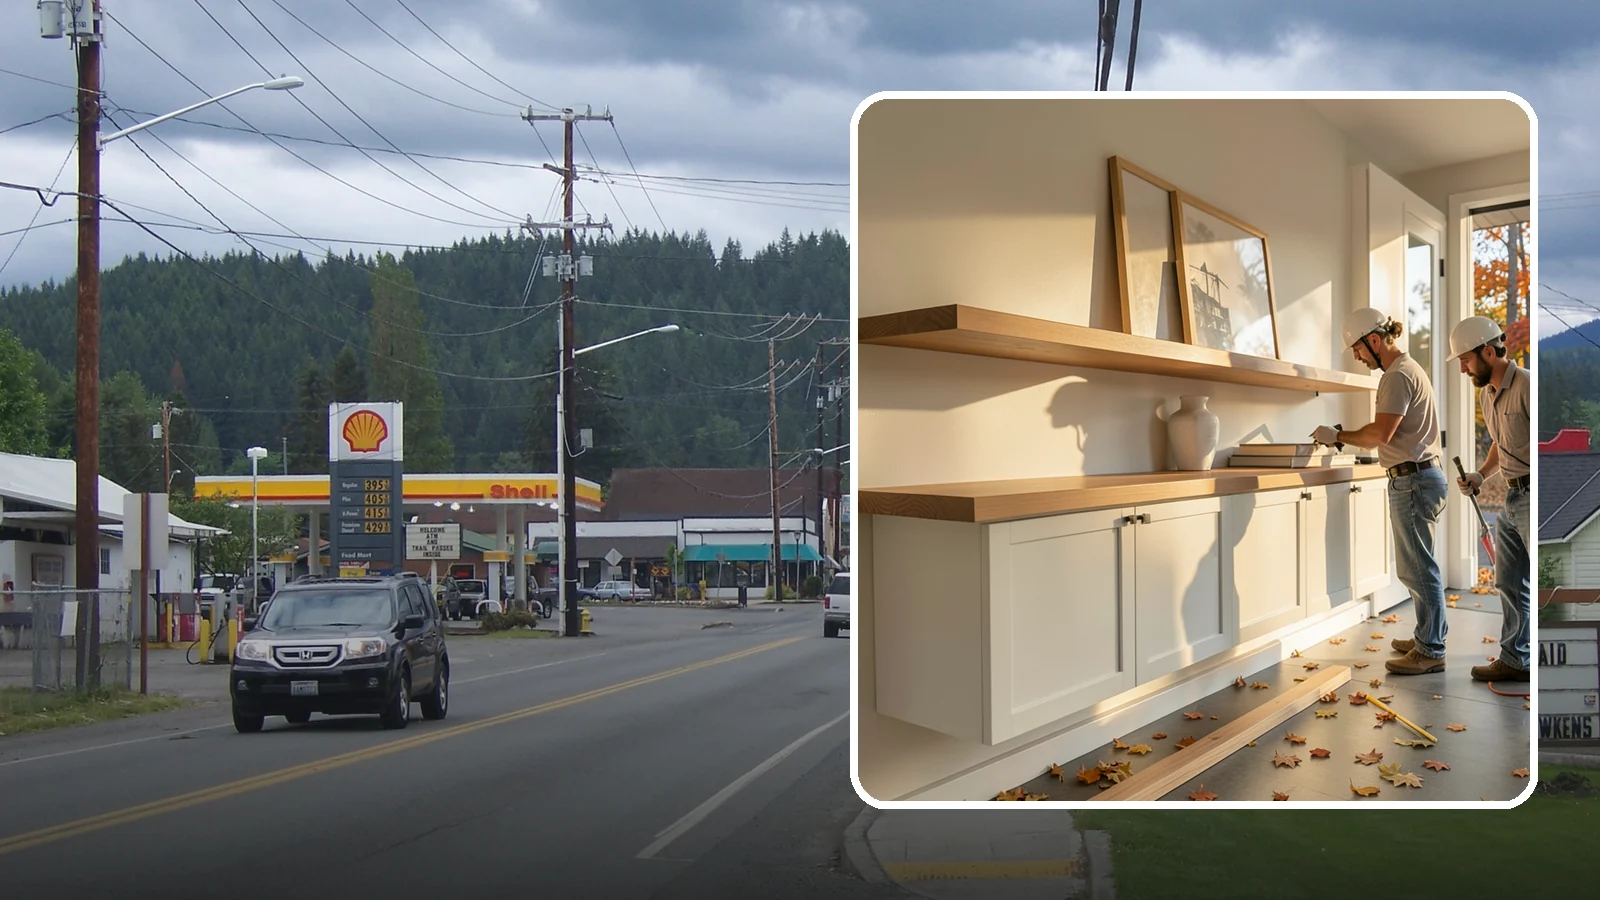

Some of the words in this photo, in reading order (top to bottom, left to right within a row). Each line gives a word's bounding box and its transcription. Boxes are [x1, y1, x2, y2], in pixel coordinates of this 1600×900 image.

[366, 480, 383, 490] 395
[490, 484, 547, 499] Shell
[366, 494, 383, 504] 405
[366, 508, 383, 518] 415
[366, 522, 383, 532] 429
[1539, 643, 1567, 665] AID
